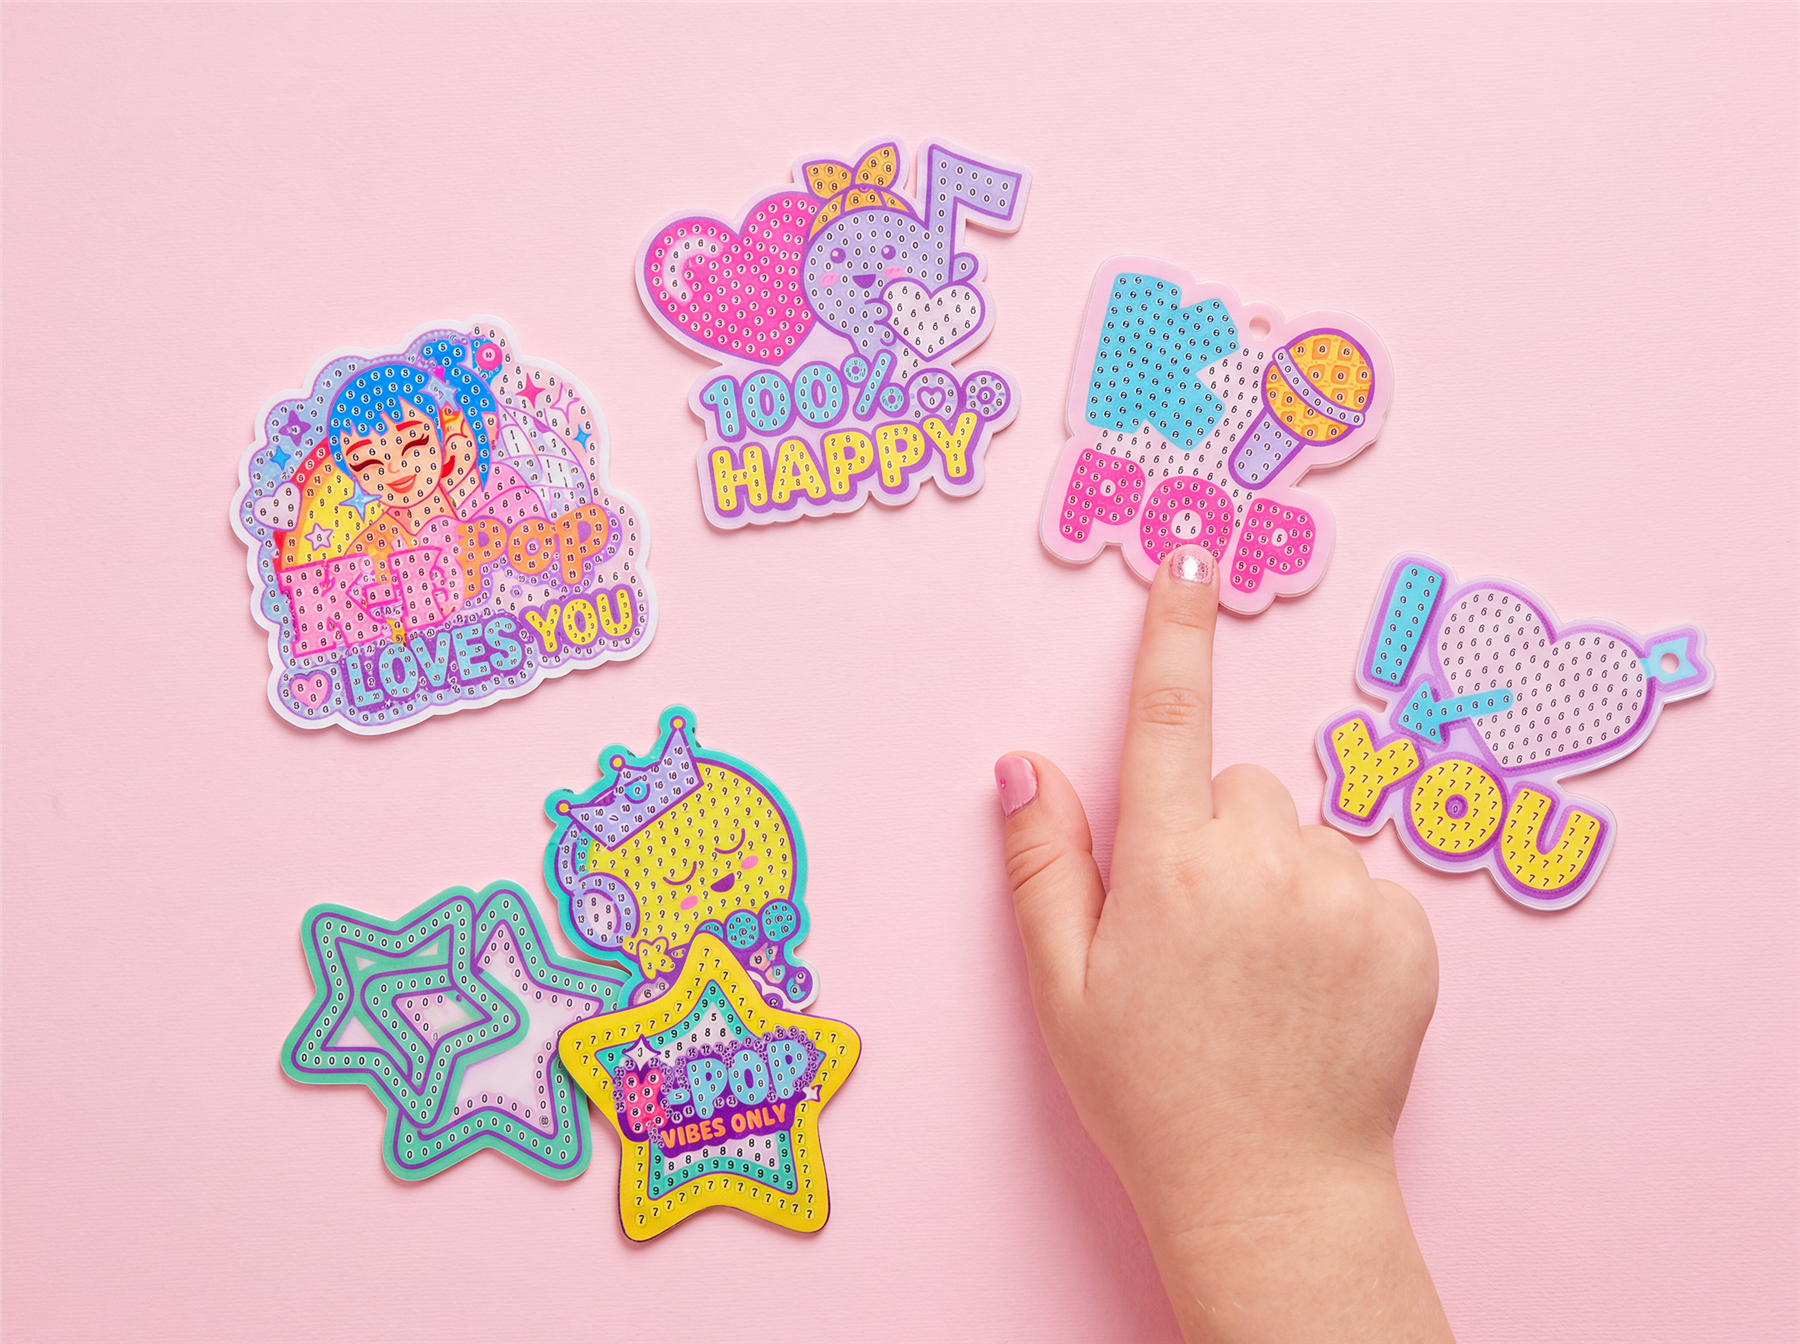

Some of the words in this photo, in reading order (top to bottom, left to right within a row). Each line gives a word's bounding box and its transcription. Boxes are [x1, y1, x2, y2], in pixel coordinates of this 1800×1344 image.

[1085, 272, 1241, 451] K
[1222, 359, 1228, 367] 6
[1224, 374, 1230, 383] 6
[703, 353, 904, 437] 100%
[1251, 395, 1258, 404] 6
[1237, 421, 1244, 430] 6
[1205, 441, 1211, 449] 6
[712, 412, 977, 511] HAPPY
[1178, 466, 1184, 474] 6
[1059, 448, 1316, 594] POP
[1175, 525, 1181, 534] 6
[457, 505, 609, 600] POP
[1487, 593, 1494, 602] 6
[1502, 596, 1508, 605] 6
[525, 589, 634, 653] YOU
[1371, 563, 1443, 684] I
[1486, 638, 1492, 646] 6
[1504, 634, 1510, 643] 6
[1579, 637, 1586, 646] 6
[1608, 640, 1615, 649] 6
[349, 617, 522, 708] LOVES
[1482, 665, 1488, 674] 6
[1535, 673, 1541, 681] 6
[1531, 688, 1538, 697] 6
[1607, 684, 1614, 693] 6
[1617, 702, 1623, 711] 6
[1507, 710, 1513, 719] 6
[1352, 722, 1359, 731] 7
[1514, 724, 1520, 733] 6
[1357, 737, 1364, 746] 7
[1523, 737, 1529, 746] 6
[1530, 751, 1536, 760] 6
[1376, 758, 1382, 767] 7
[1393, 766, 1399, 776] 7
[1452, 763, 1459, 772] 7
[1426, 775, 1433, 784] 7
[1417, 787, 1424, 796] 7
[1523, 791, 1530, 800] 7
[1331, 718, 1601, 890] YOU
[1343, 798, 1350, 808] 7
[1433, 801, 1439, 811] 7
[1358, 804, 1365, 813] 7
[1516, 805, 1523, 814] 7
[1489, 817, 1495, 826] 7
[1575, 814, 1581, 823] 7
[1527, 826, 1534, 835] 7
[1506, 835, 1513, 844] 7
[1583, 835, 1590, 845] 7
[1454, 840, 1461, 849] 7
[1542, 859, 1549, 869] 7
[1543, 877, 1550, 887] 7
[591, 897, 597, 907] 8
[605, 904, 611, 914] 8
[594, 913, 599, 923] 8
[607, 921, 612, 930] 8
[704, 948, 710, 957] 7
[699, 962, 705, 972] 7
[714, 959, 720, 968] 7
[723, 971, 729, 980] 7
[695, 977, 701, 986] 7
[709, 986, 716, 995] 9
[731, 984, 737, 993] 7
[686, 990, 692, 999] 7
[701, 999, 708, 1008] 9
[718, 999, 725, 1008] 9
[739, 997, 745, 1006] 7
[676, 1003, 682, 1012] 7
[664, 1013, 670, 1022] 7
[693, 1012, 700, 1022] 9
[727, 1013, 734, 1023] 9
[747, 1009, 753, 1019] 7
[650, 1020, 655, 1029] 7
[605, 1031, 611, 1041] 7
[621, 1027, 626, 1037] 7
[671, 1029, 678, 1039] 9
[704, 1027, 711, 1037] 8
[657, 1036, 664, 1045] 9
[691, 1033, 697, 1043] 8
[831, 1033, 836, 1043] 7
[575, 1041, 582, 1050] 7
[582, 1055, 589, 1064] 7
[831, 1059, 837, 1069] 7
[731, 1103, 787, 1133] ONLY
[797, 1118, 803, 1128] 7
[661, 1117, 726, 1149] VIBES
[779, 1133, 786, 1143] 9
[765, 1139, 771, 1149] 8
[702, 1148, 709, 1158] 8
[719, 1146, 726, 1156] 8
[736, 1148, 743, 1158] 8
[781, 1148, 788, 1158] 9
[799, 1148, 806, 1158] 7
[654, 1155, 662, 1164] 9
[712, 1159, 719, 1169] 9
[768, 1158, 775, 1168] 8
[637, 1162, 643, 1172] 7
[668, 1161, 675, 1171] 8
[697, 1163, 704, 1173] 9
[727, 1160, 734, 1170] 9
[757, 1169, 764, 1178] 9
[723, 1178, 729, 1188] 7
[772, 1174, 779, 1183] 9
[636, 1179, 643, 1189] 7
[708, 1180, 714, 1190] 7
[805, 1179, 811, 1188] 7
[652, 1186, 660, 1196] 9
[752, 1187, 758, 1197] 7
[636, 1196, 642, 1206] 7
[679, 1192, 685, 1202] 7
[779, 1199, 785, 1209] 7
[653, 1207, 659, 1217] 7
[807, 1209, 813, 1219] 7
[638, 1214, 645, 1224] 7
